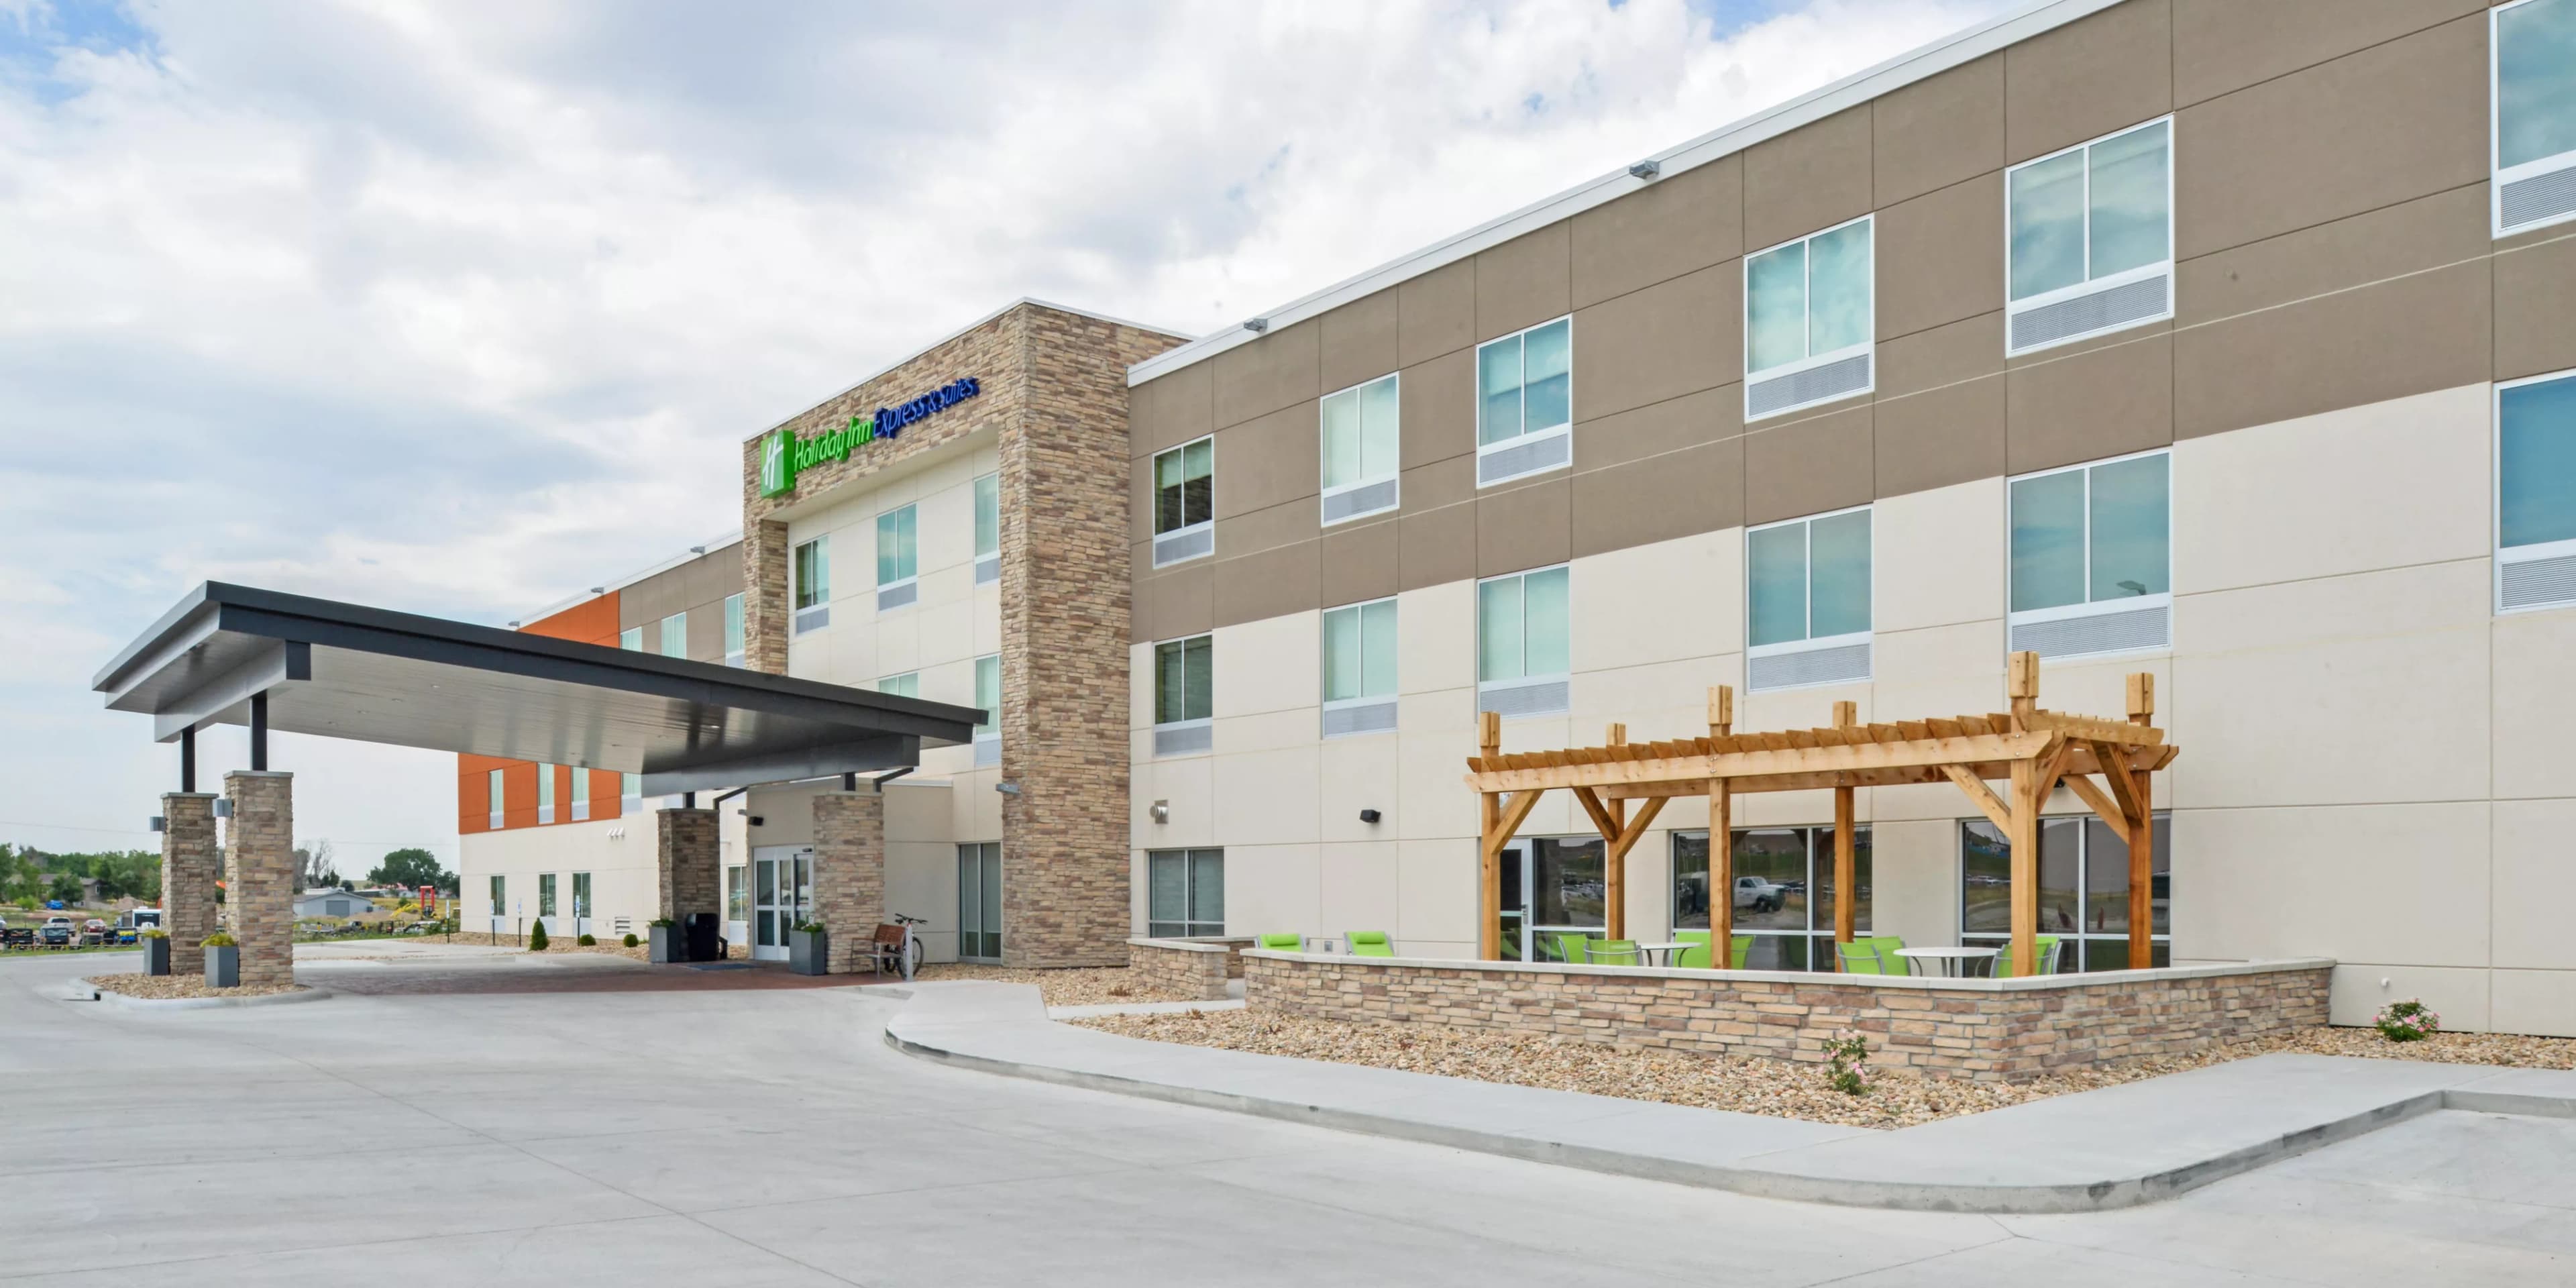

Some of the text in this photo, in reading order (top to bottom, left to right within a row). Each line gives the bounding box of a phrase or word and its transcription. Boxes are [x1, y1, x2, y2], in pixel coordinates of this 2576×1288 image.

[794, 378, 978, 472] Holiday Inn Express & Suites
